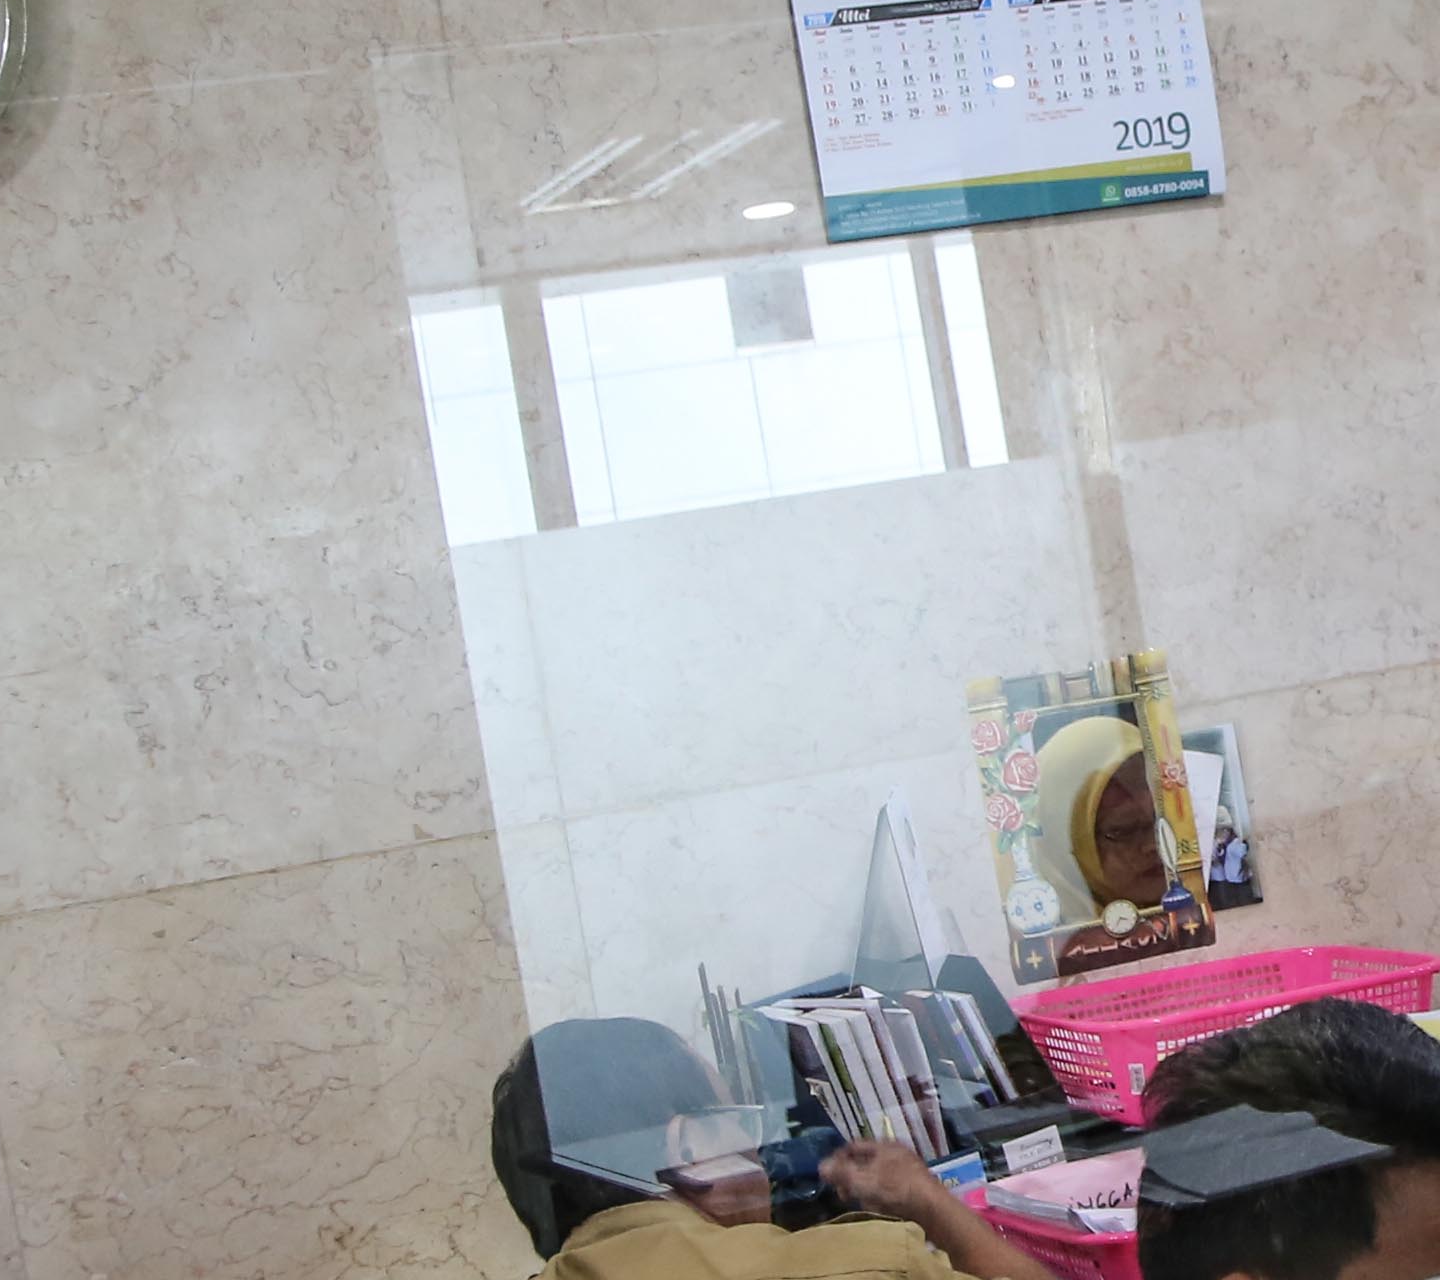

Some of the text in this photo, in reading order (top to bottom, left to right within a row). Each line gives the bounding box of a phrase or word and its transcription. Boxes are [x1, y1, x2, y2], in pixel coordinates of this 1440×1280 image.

[981, 50, 990, 59] 11
[1052, 59, 1062, 69] 10
[1079, 56, 1087, 66] 11
[1104, 52, 1114, 63] 12
[1129, 50, 1140, 60] 13
[1155, 47, 1166, 57] 14
[823, 84, 833, 94] 12
[850, 81, 860, 91] 13
[876, 78, 888, 88] 14
[903, 75, 914, 85] 15
[930, 72, 940, 82] 16
[956, 69, 967, 79] 17
[1028, 78, 1039, 88] 16
[1054, 75, 1064, 85] 17
[1081, 72, 1091, 82] 18
[1106, 70, 1117, 79] 19
[1132, 66, 1143, 76] 20
[826, 100, 836, 111] 19
[852, 97, 863, 108] 20
[880, 95, 890, 104] 21
[907, 92, 917, 101] 22
[933, 89, 943, 99] 23
[960, 85, 970, 95] 24
[1057, 91, 1067, 100] 24
[1083, 88, 1093, 98] 25
[1110, 85, 1120, 95] 26
[1135, 82, 1144, 92] 27
[1160, 79, 1170, 89] 28
[828, 117, 840, 127] 26
[855, 115, 866, 124] 27
[882, 111, 893, 121] 28
[909, 108, 919, 118] 29
[962, 101, 972, 111] 31
[1113, 111, 1191, 150] 2019
